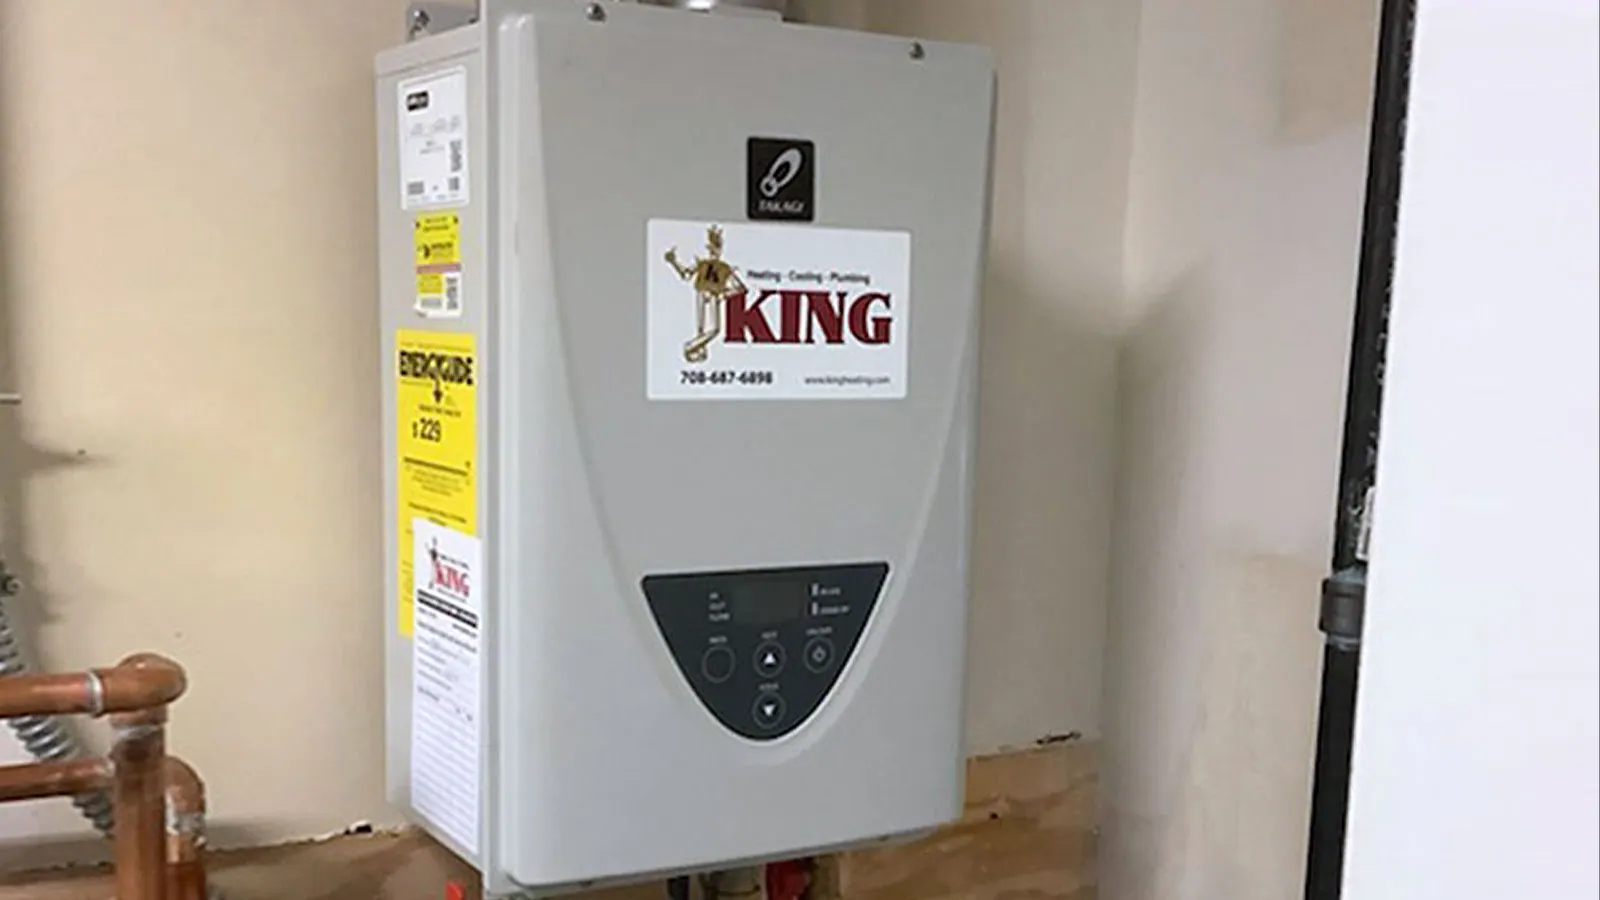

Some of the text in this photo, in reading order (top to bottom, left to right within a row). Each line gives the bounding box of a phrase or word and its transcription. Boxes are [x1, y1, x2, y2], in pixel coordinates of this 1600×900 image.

[758, 199, 804, 214] TAKAGI
[747, 269, 870, 286] Heating Cooling Plumbing
[724, 289, 892, 344] KING
[680, 370, 774, 385] 708-687-6898
[435, 560, 471, 598] KING
